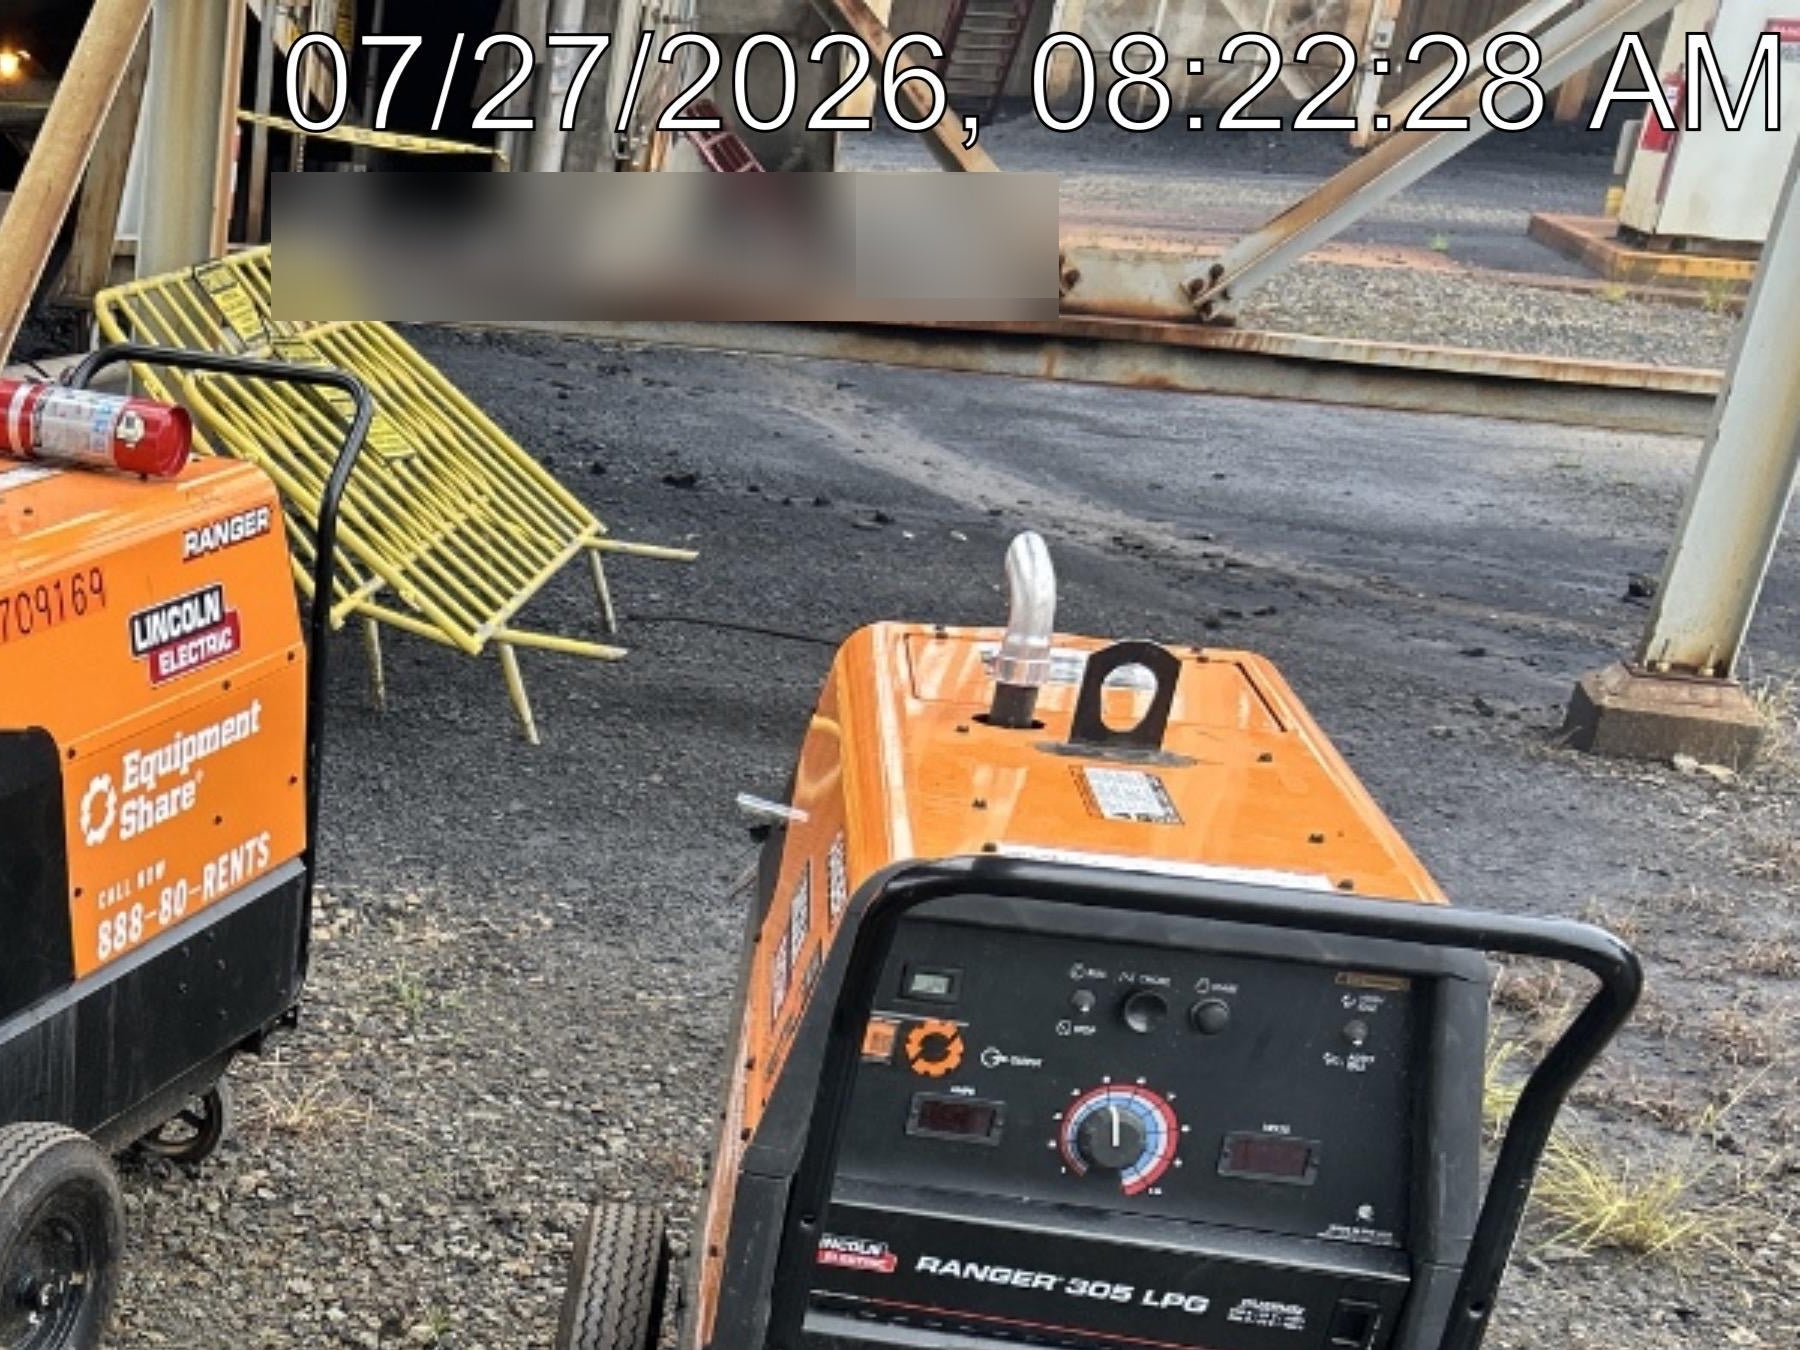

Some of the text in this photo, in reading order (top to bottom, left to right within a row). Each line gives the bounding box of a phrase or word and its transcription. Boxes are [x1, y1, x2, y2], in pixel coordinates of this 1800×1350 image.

[183, 505, 270, 558] RANGER
[134, 590, 221, 651] LINCOLN
[158, 627, 233, 676] ELECTRIC
[122, 698, 262, 793] Equipment
[119, 779, 197, 841] Share
[97, 831, 271, 961] 888-80-RENTS
[914, 1255, 1061, 1292] RANGER
[1064, 1277, 1135, 1303] 305
[1141, 1289, 1210, 1316] LPG
